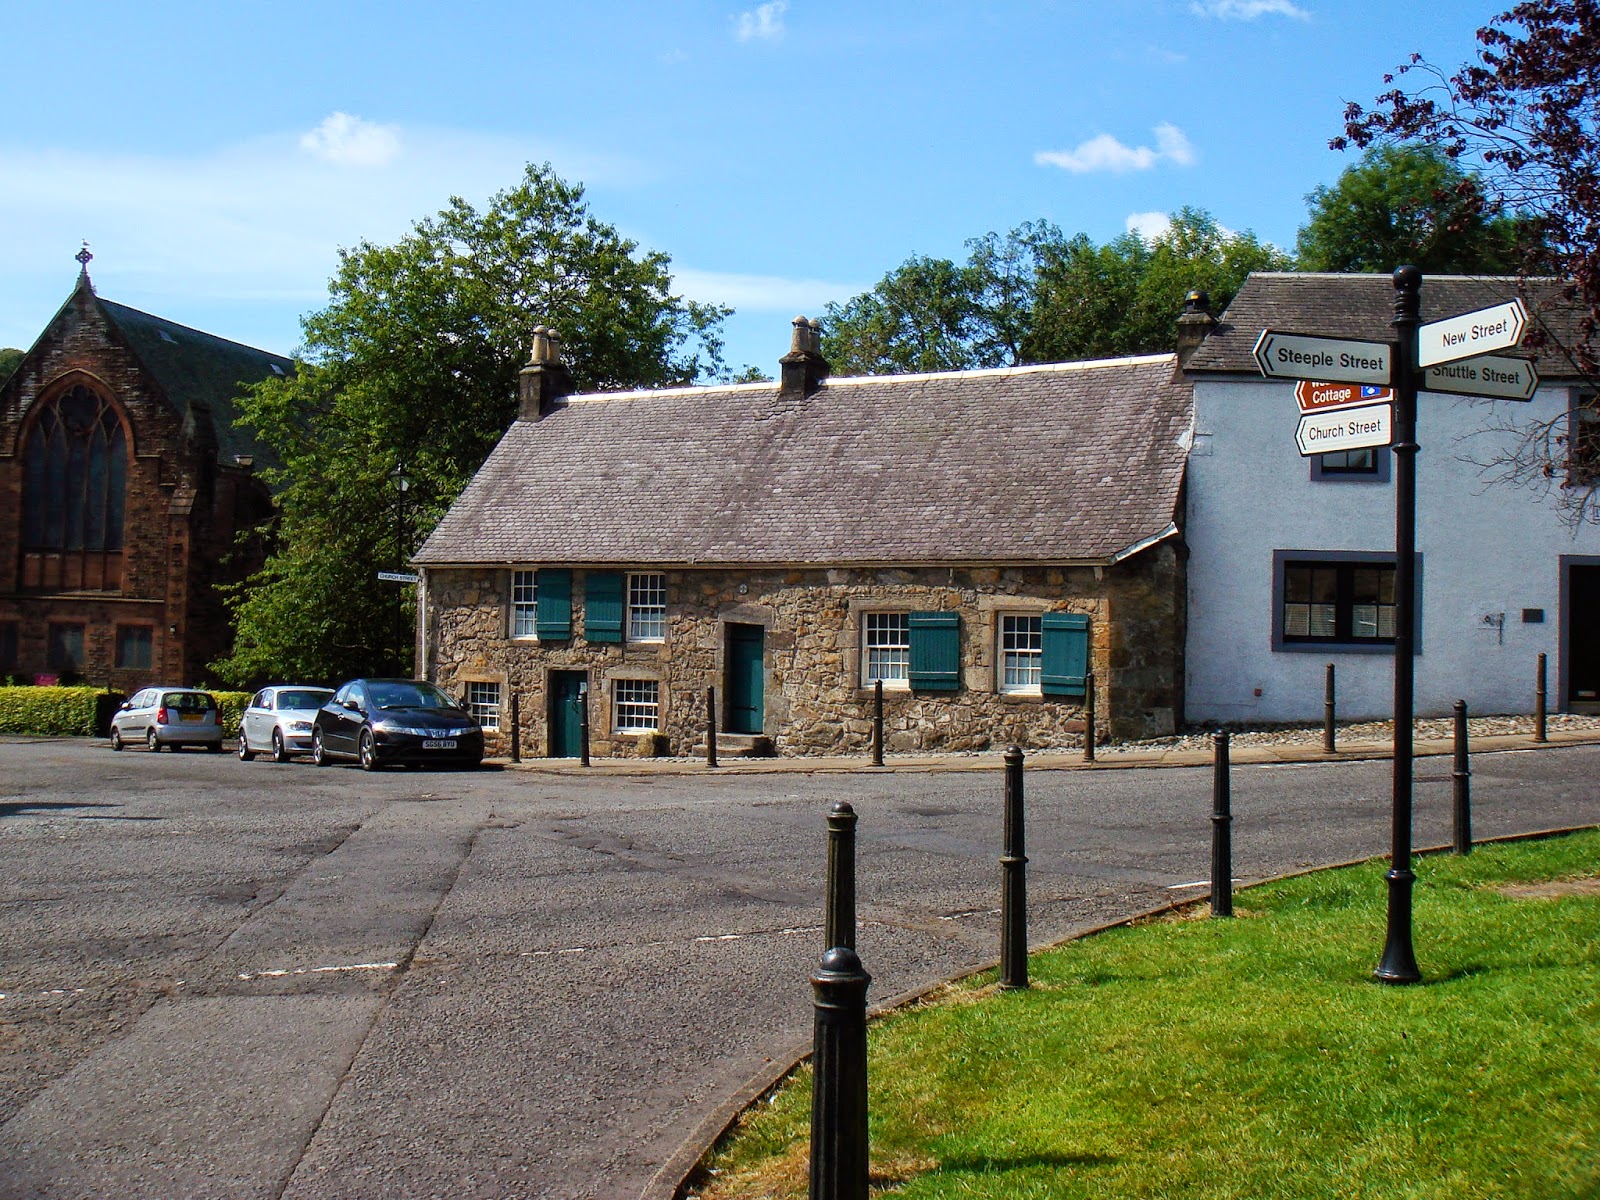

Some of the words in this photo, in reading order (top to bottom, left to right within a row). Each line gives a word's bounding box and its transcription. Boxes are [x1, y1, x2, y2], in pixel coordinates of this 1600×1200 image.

[1442, 331, 1466, 347] New
[1471, 319, 1507, 340] Street
[1278, 347, 1333, 367] Steeple
[1340, 353, 1383, 370] Street
[1432, 365, 1476, 379] Shuttle
[1482, 367, 1520, 384] Street
[1312, 388, 1351, 404] Cottage
[1309, 423, 1344, 440] Church
[1348, 419, 1381, 435] Street
